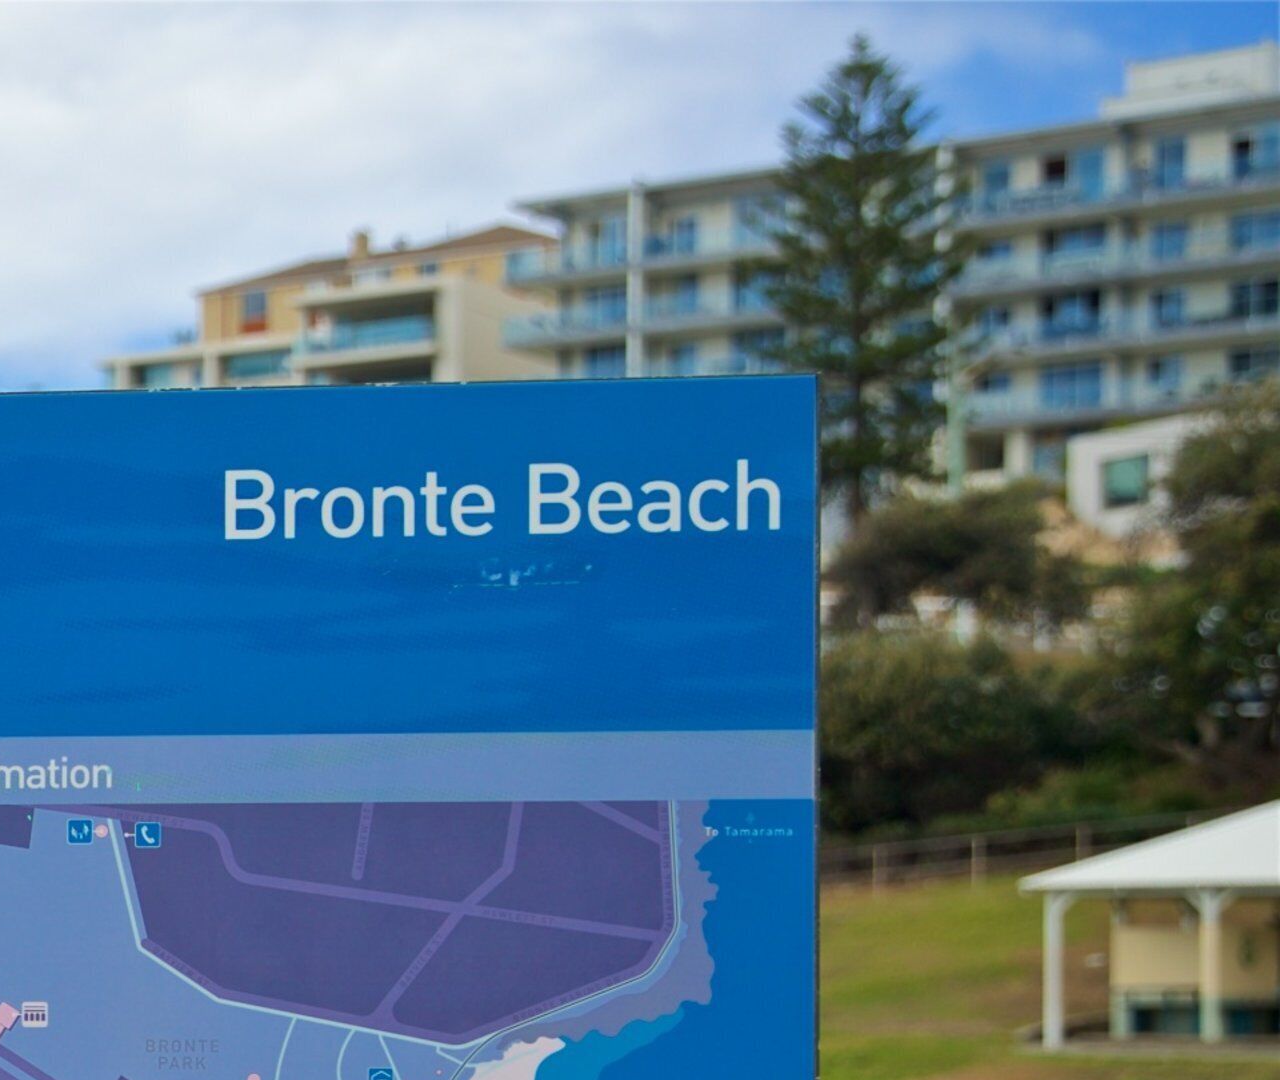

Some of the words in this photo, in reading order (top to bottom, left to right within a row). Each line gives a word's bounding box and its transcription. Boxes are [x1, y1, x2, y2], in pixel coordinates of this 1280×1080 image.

[225, 470, 495, 540] Bronte
[529, 459, 780, 535] Beach
[704, 827, 719, 838] To
[725, 827, 793, 836] Tamarama
[146, 1039, 218, 1053] BRONTE
[158, 1056, 205, 1070] PARK
